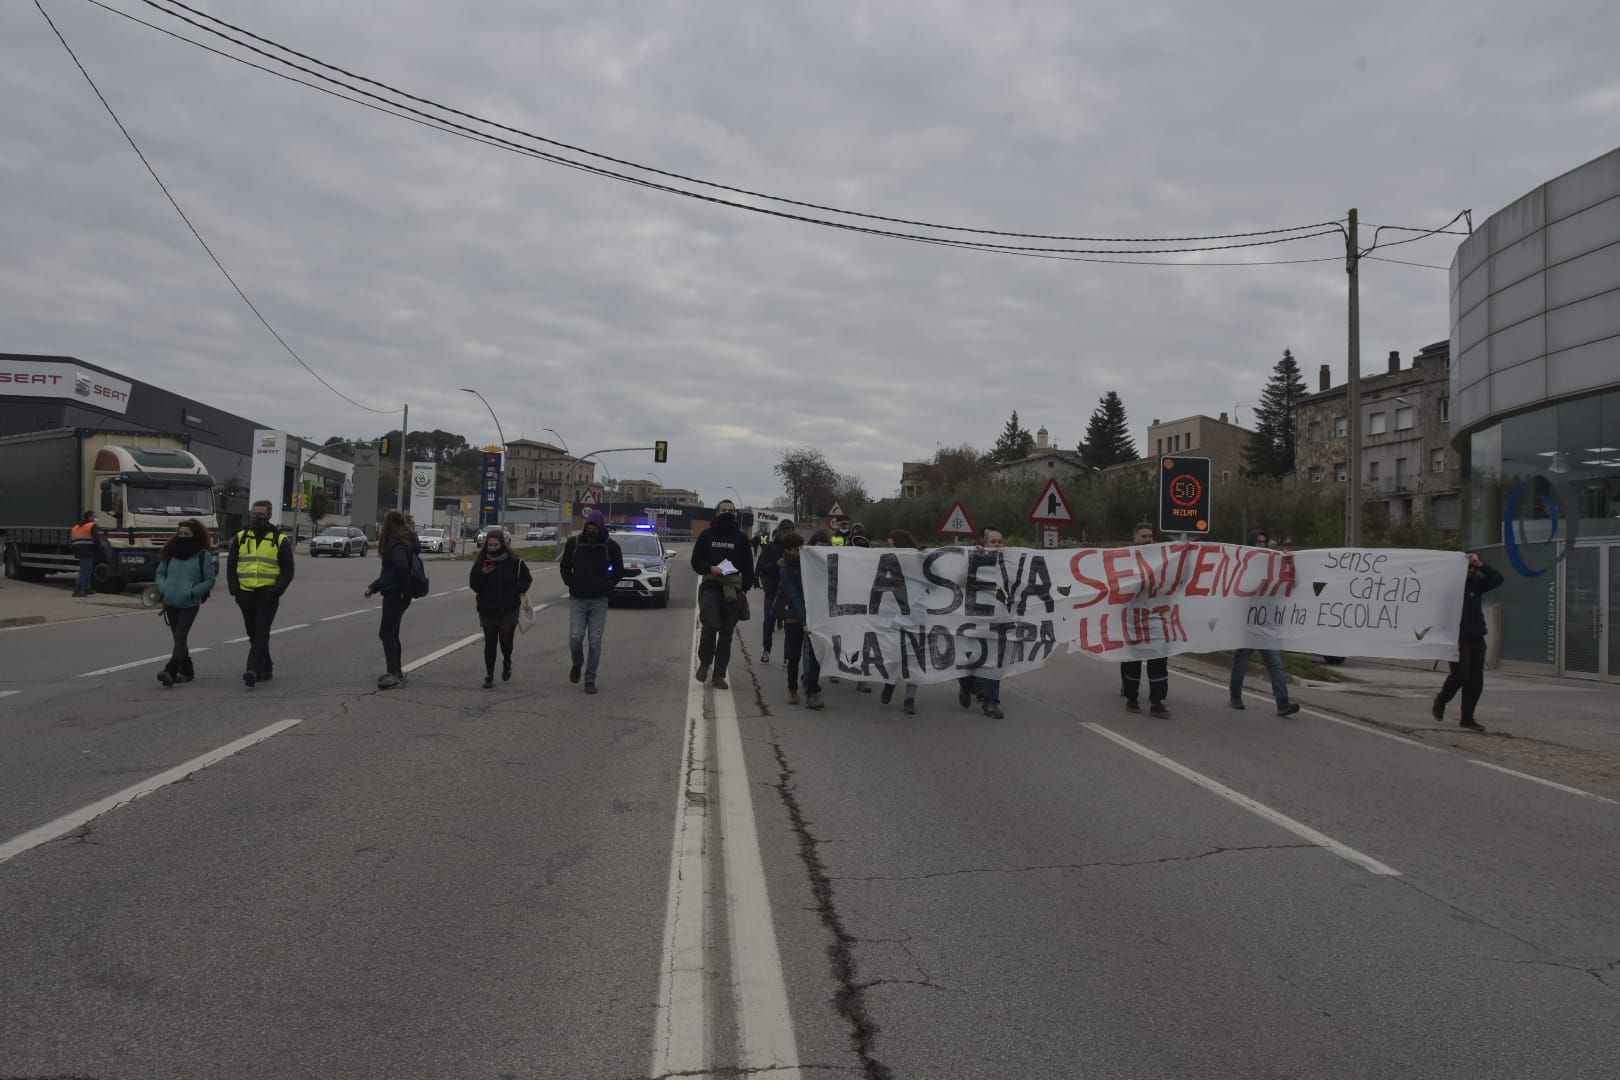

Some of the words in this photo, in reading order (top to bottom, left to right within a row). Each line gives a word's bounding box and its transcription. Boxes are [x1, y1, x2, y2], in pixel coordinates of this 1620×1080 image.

[0, 373, 62, 385] SEAT
[94, 384, 128, 402] SEAT
[1175, 482, 1196, 498] 50
[827, 553, 911, 617] LA
[922, 547, 1055, 617] SEVA
[1247, 605, 1267, 626] no
[1290, 603, 1307, 625] ha
[1317, 602, 1400, 629] ESCOLA!
[832, 631, 890, 681] LA
[900, 620, 1056, 680] NOSTRA
[1079, 604, 1189, 654] LLUITA
